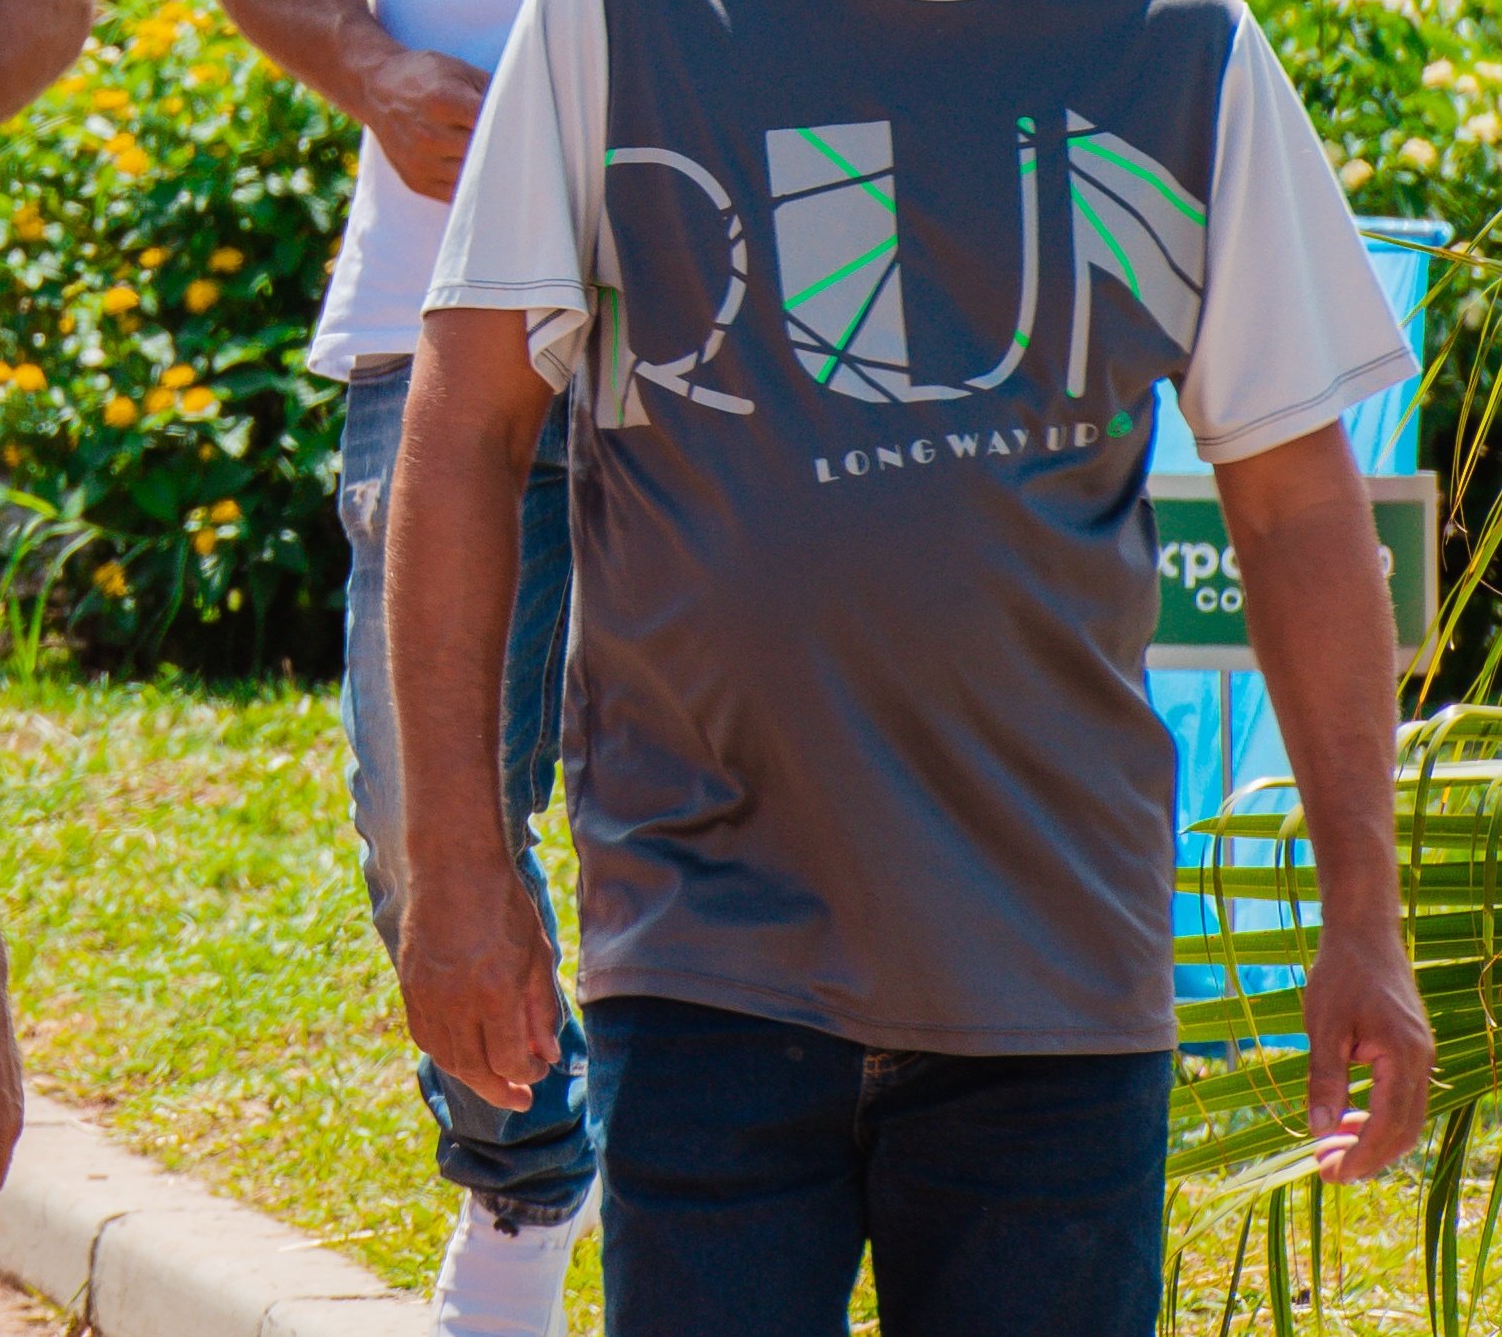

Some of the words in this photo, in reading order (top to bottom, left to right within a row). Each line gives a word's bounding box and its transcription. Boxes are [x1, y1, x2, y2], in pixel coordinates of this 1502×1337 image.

[595, 108, 1206, 430] RUN
[814, 438, 937, 484] LONG
[944, 424, 1030, 462] WAY
[1044, 420, 1101, 453] UP
